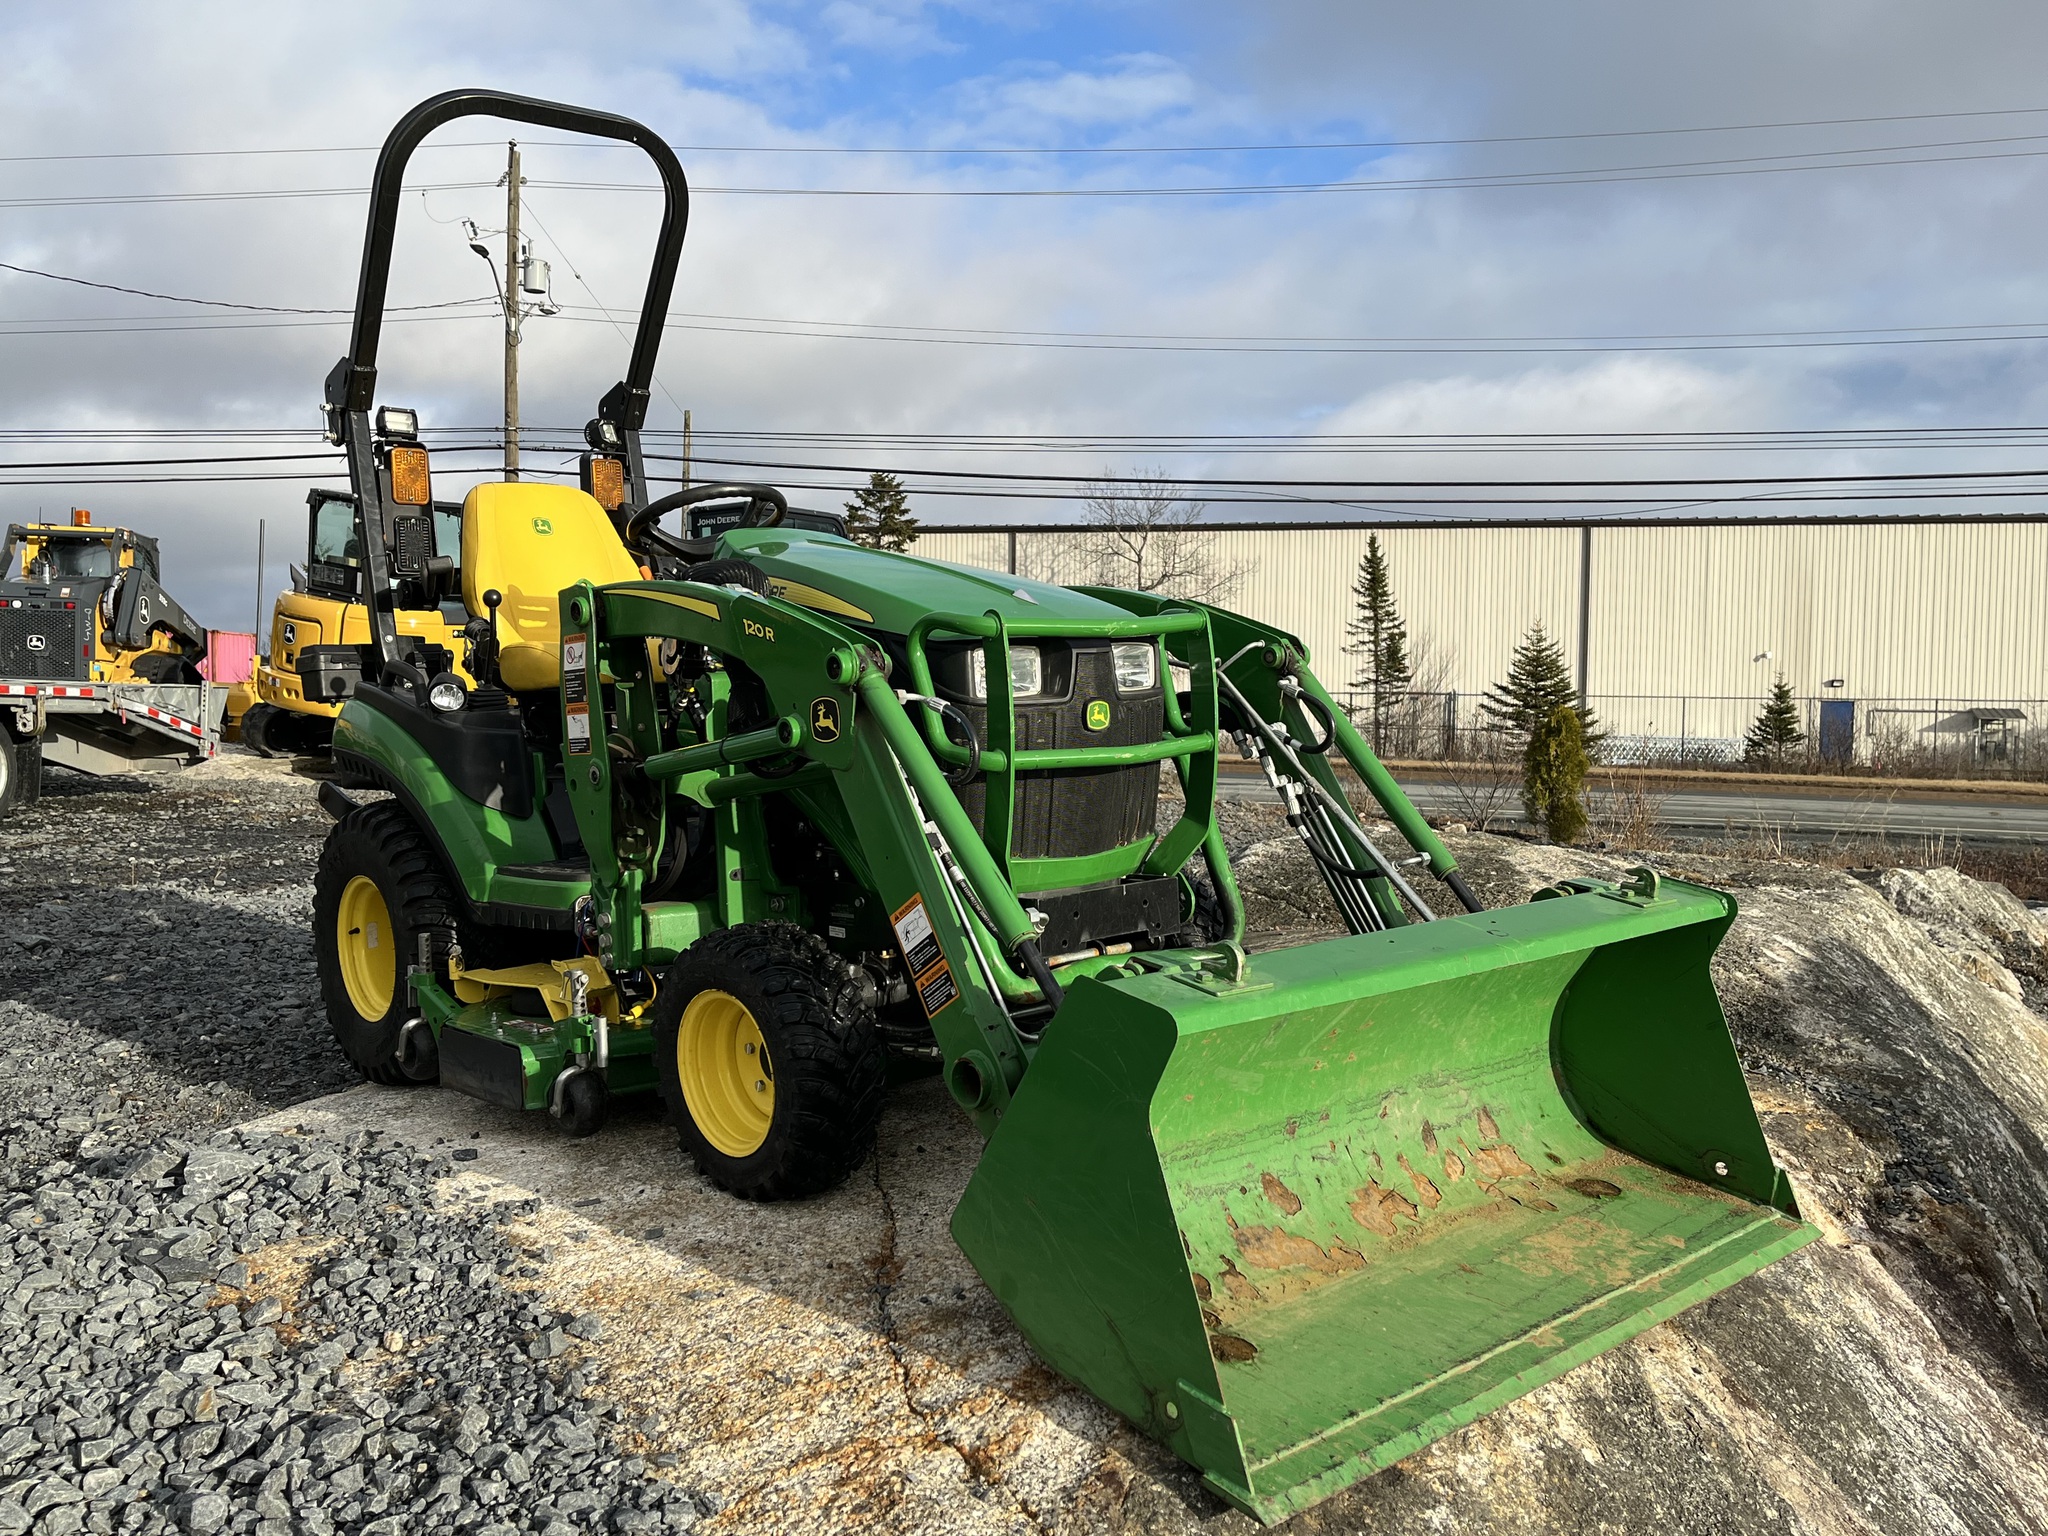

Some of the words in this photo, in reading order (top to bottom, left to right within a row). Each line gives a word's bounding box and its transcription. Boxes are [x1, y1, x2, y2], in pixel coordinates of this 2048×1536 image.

[697, 518, 716, 526] JOHN
[716, 516, 741, 524] DEERE
[899, 898, 918, 916] WARNING
[925, 964, 945, 983] WARNING
